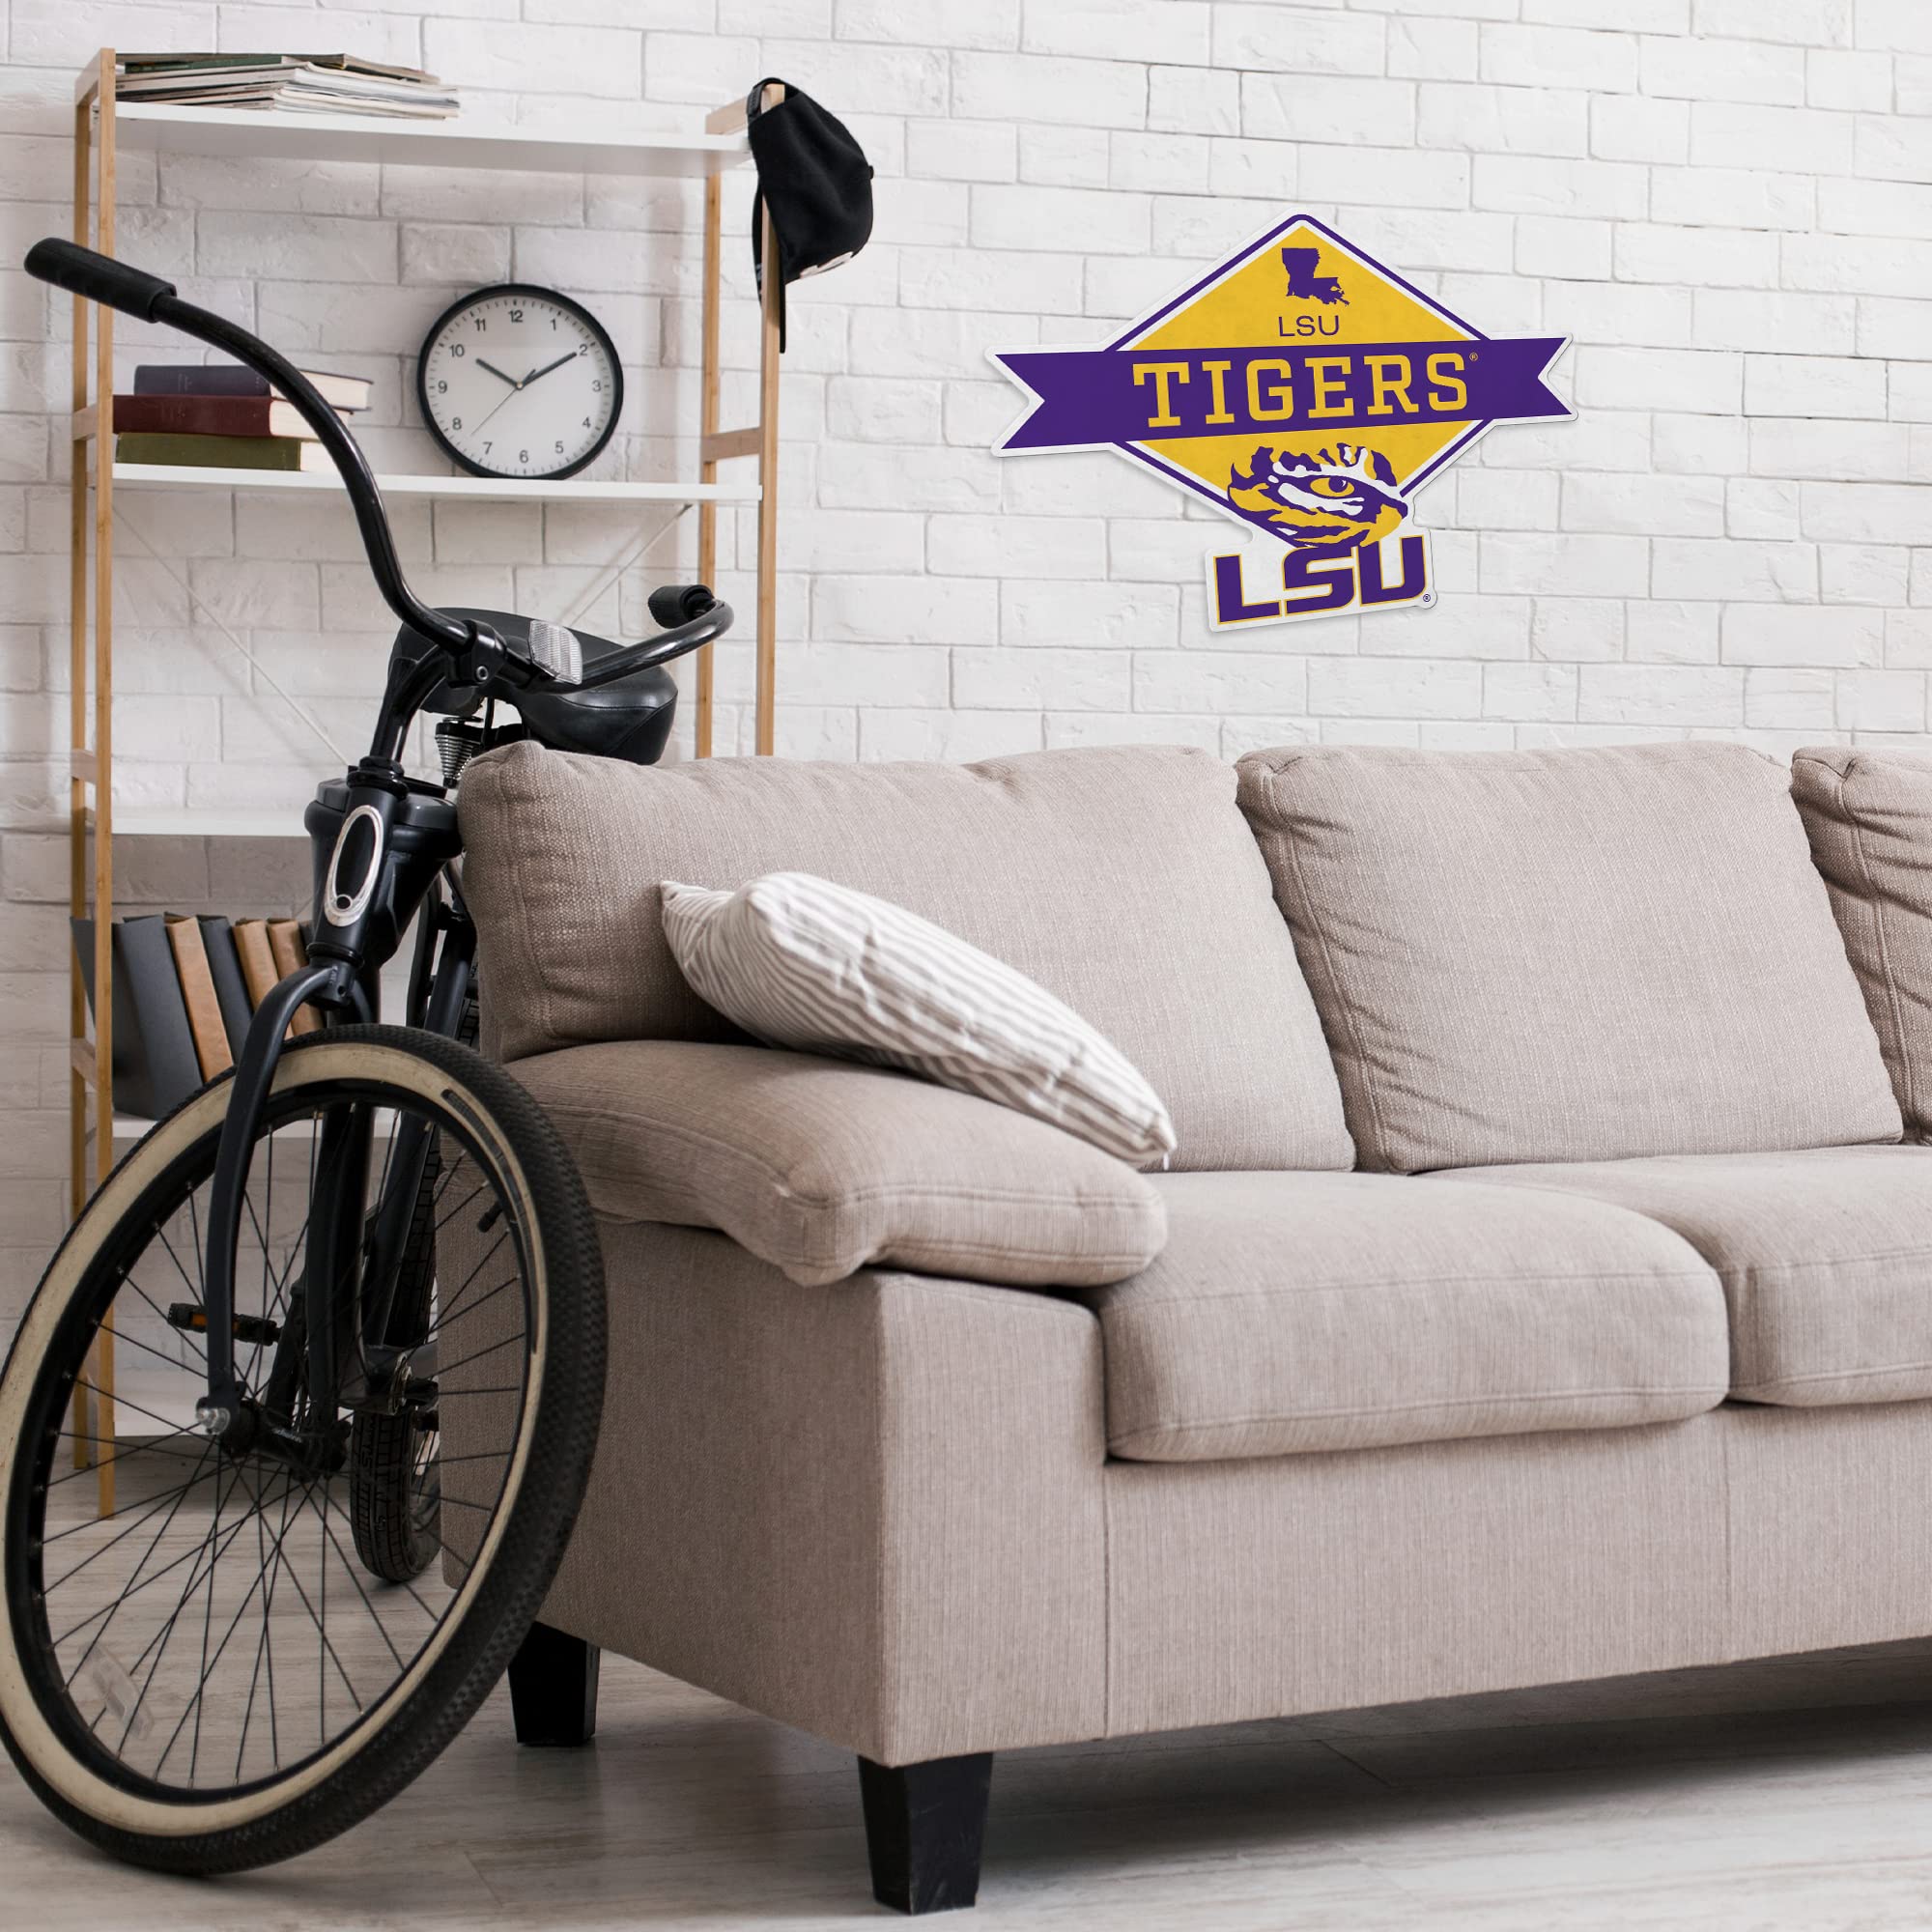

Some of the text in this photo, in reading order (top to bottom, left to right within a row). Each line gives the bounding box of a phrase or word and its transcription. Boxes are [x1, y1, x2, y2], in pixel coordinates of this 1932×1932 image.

[508, 309, 524, 324] 12
[474, 318, 487, 332] 11
[550, 318, 557, 331] 1
[1278, 315, 1340, 337] LSU
[449, 343, 466, 357] 10
[579, 343, 588, 356] 2
[438, 380, 448, 394] 9
[592, 380, 602, 393] 3
[452, 416, 463, 431] 8
[582, 416, 591, 429] 4
[482, 440, 493, 455] 7
[554, 440, 564, 454] 5
[519, 449, 529, 464] 6
